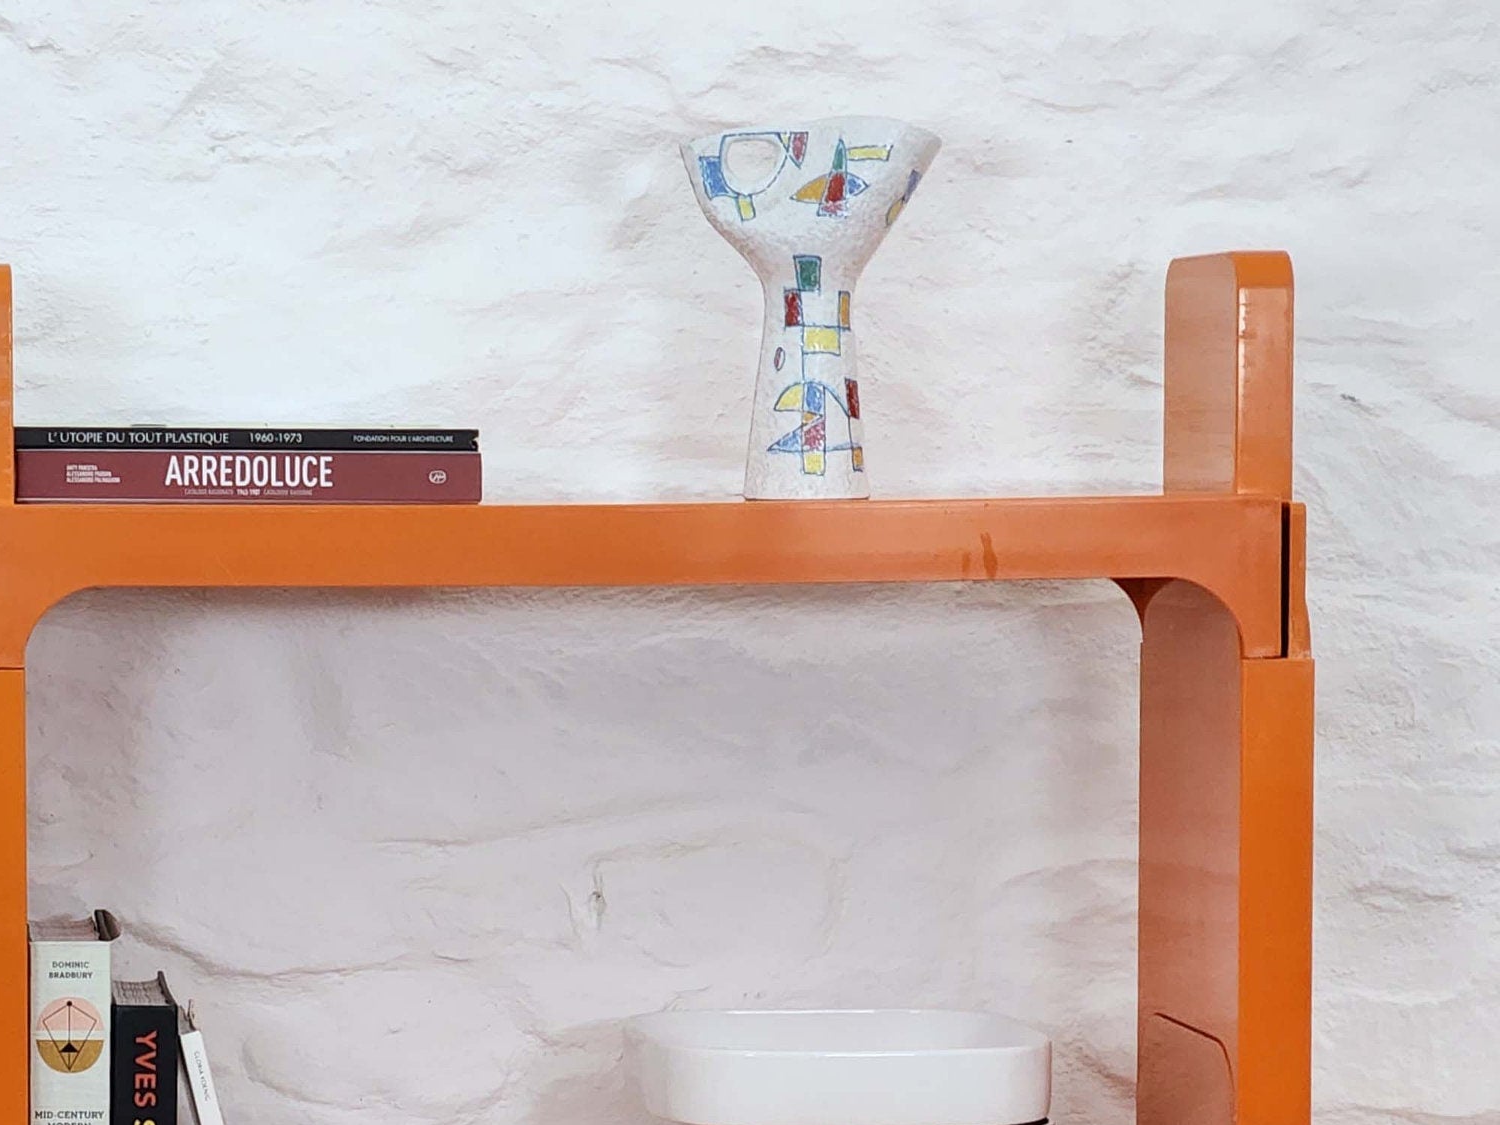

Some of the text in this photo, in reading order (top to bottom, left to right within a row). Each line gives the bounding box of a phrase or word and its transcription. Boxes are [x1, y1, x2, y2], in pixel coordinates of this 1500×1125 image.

[60, 432, 103, 443] UTOPIE
[106, 432, 125, 443] DU
[128, 432, 162, 443] TOUT
[165, 432, 229, 445] PLASTIQUE
[165, 455, 334, 487] ARREDOLUCE
[52, 961, 90, 969] DOMINIC
[134, 1030, 158, 1108] YVES
[35, 1111, 104, 1119] MID-CENTURY
